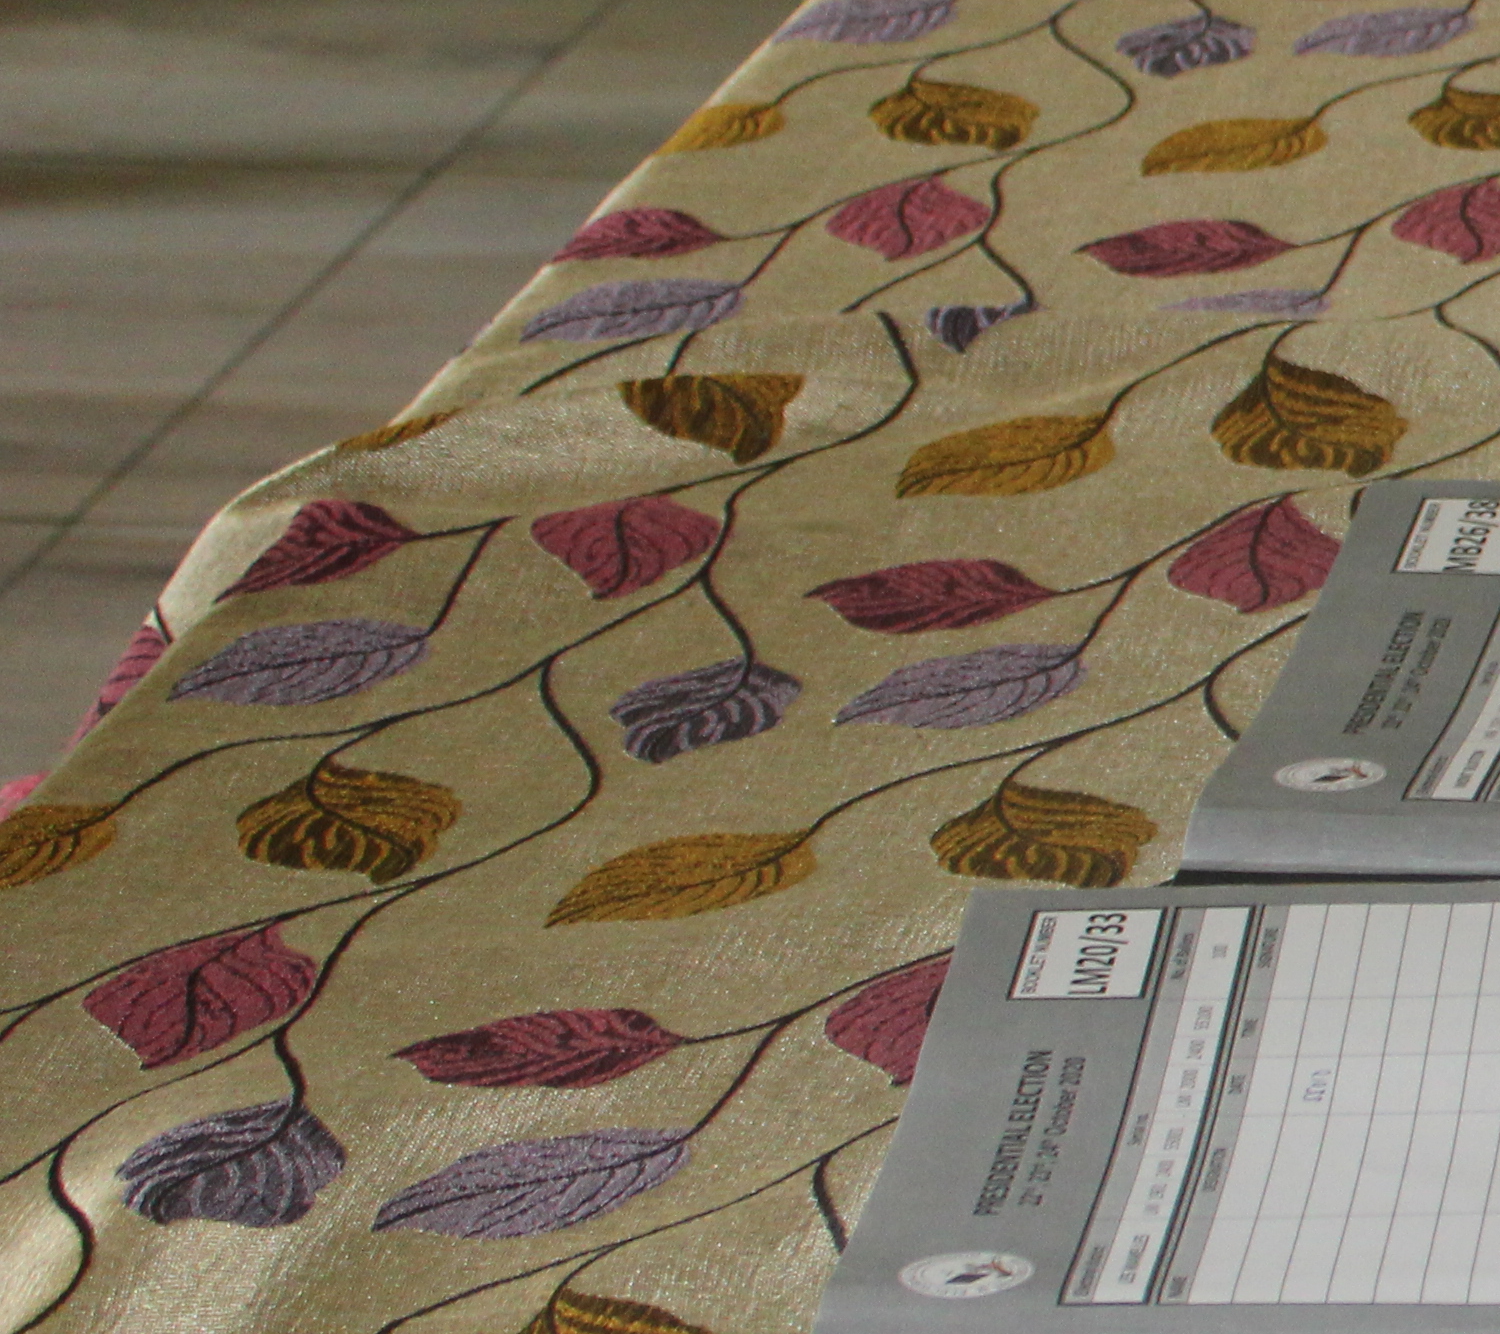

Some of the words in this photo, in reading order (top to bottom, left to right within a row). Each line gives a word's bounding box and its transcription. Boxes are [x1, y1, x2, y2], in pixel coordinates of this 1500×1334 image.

[1443, 501, 1500, 570] MB26/38
[1342, 667, 1400, 734] PRESIDENTIAL
[1382, 611, 1424, 664] ELECTION
[1409, 640, 1439, 676] October
[1427, 619, 1451, 638] 2020
[1031, 915, 1058, 955] NUMBER
[1066, 913, 1130, 995] LM20/33
[1020, 956, 1049, 995] BOOKLET
[1057, 1057, 1086, 1087] 2020
[972, 1126, 1034, 1215] PRESIDENTIAL
[1007, 1050, 1053, 1123] ELECTION
[1042, 1088, 1079, 1137] October
